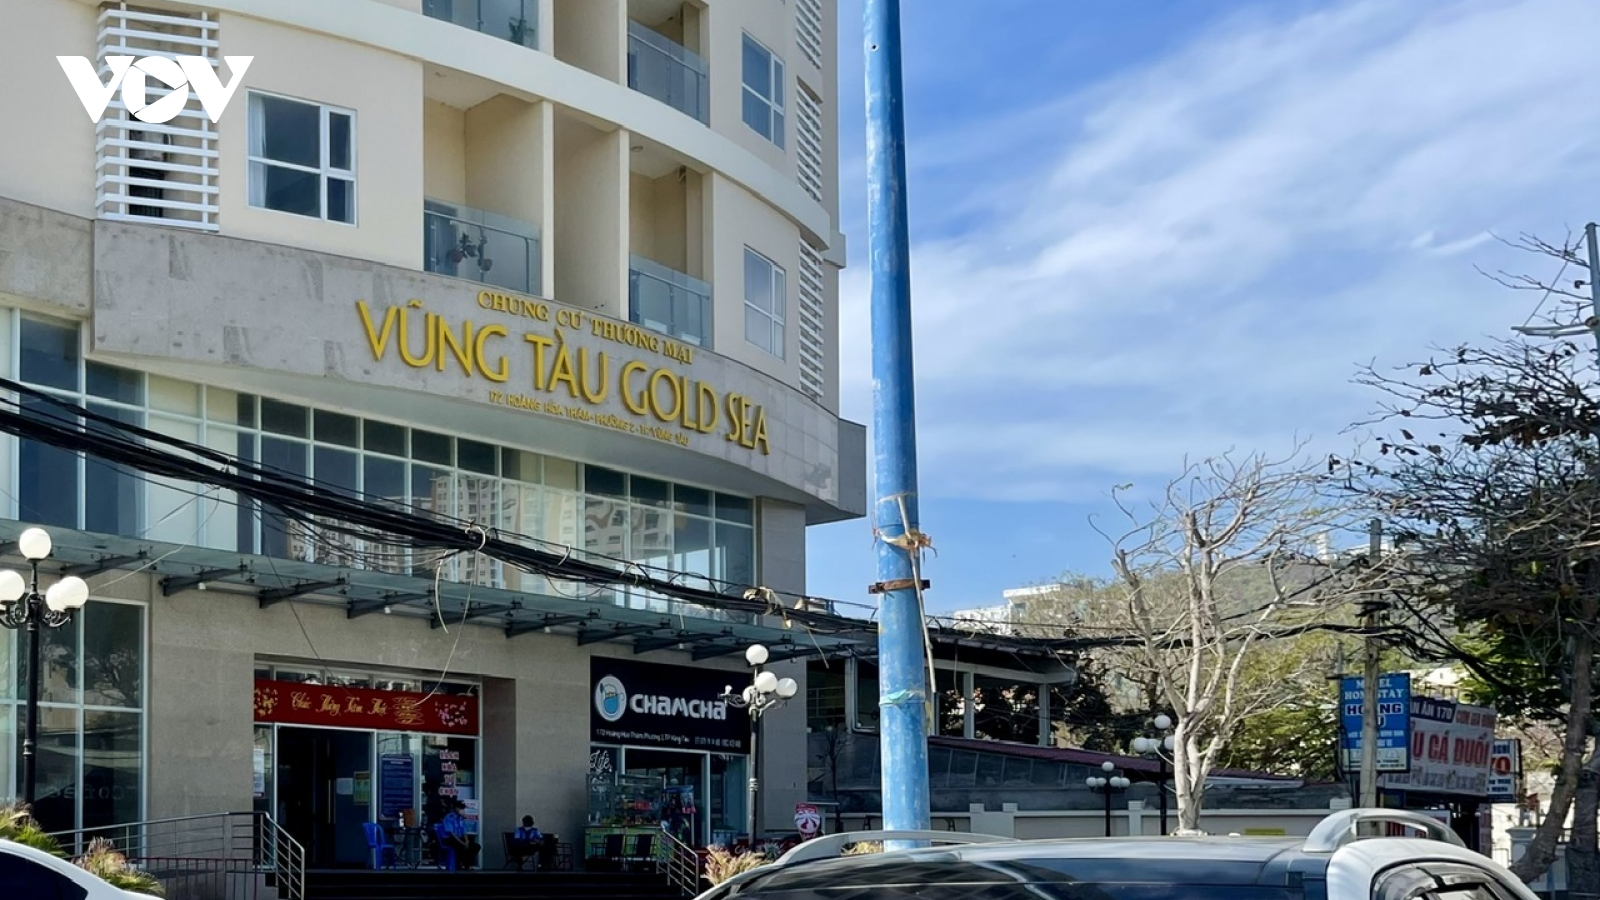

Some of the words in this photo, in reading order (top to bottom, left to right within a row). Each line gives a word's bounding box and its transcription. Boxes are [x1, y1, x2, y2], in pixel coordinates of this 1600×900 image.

[478, 289, 549, 322] CHUNG
[663, 341, 694, 366] MẠI
[355, 299, 510, 382] VŨNG
[524, 328, 610, 405] TÀU
[620, 360, 720, 434] GOLD
[725, 391, 770, 455] SEA
[489, 390, 504, 405] 172
[1436, 706, 1453, 720] 170
[1429, 729, 1450, 764] CÁ
